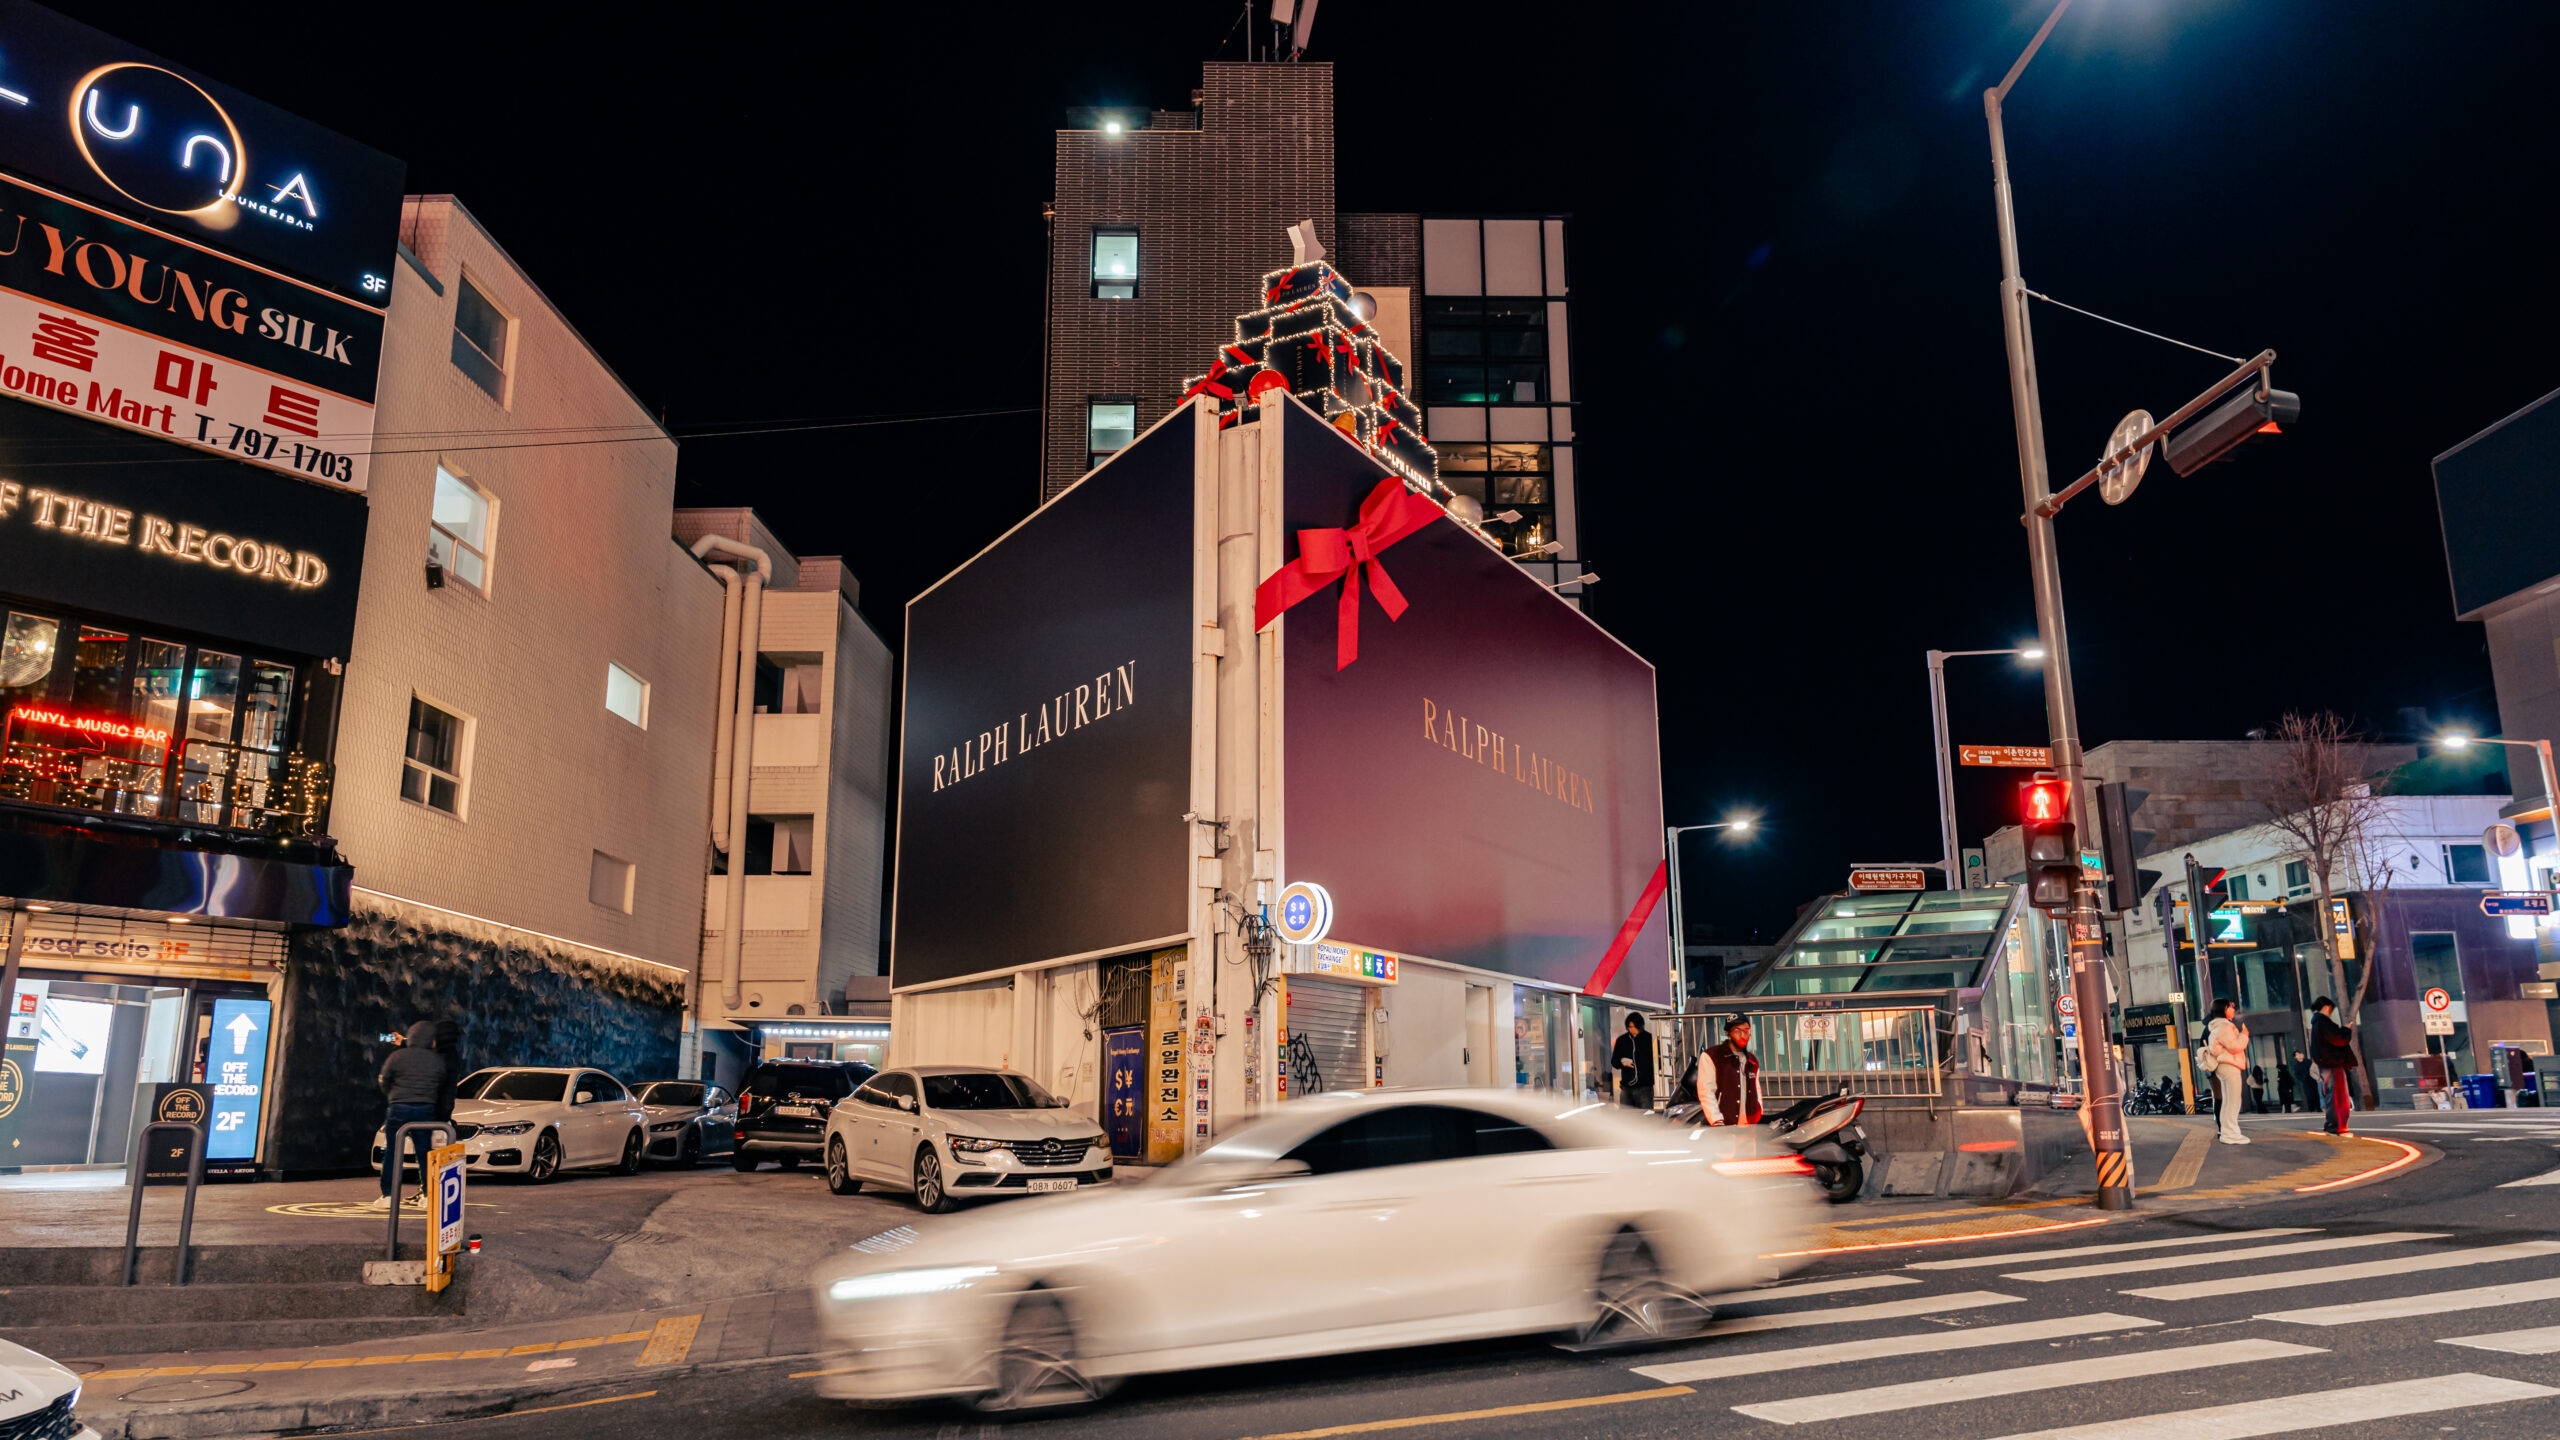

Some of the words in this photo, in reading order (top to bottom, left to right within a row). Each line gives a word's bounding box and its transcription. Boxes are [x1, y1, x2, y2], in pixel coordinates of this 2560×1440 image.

[39, 222, 251, 336] YOUNG
[258, 307, 353, 366] SILK
[362, 273, 387, 293] 3F
[86, 381, 176, 434] Mart
[195, 413, 217, 446] T.
[228, 422, 353, 484] 797-1703
[30, 488, 133, 546] THE
[140, 514, 330, 588] RECORD
[16, 708, 71, 728] VINYL
[76, 717, 130, 738] MUSIC
[134, 727, 168, 743] BAR
[932, 721, 1010, 792] RALPH
[1019, 660, 1136, 755] LAUREN
[1423, 697, 1507, 774] RALPH
[1514, 743, 1594, 815] LAUREN
[221, 1073, 248, 1084] THE
[222, 1062, 249, 1073] OFF
[166, 1111, 197, 1119] RECORD
[215, 1111, 246, 1131] 2F
[170, 1148, 184, 1158] 2F
[443, 1177, 460, 1223] P
[1053, 1181, 1073, 1190] 0607
